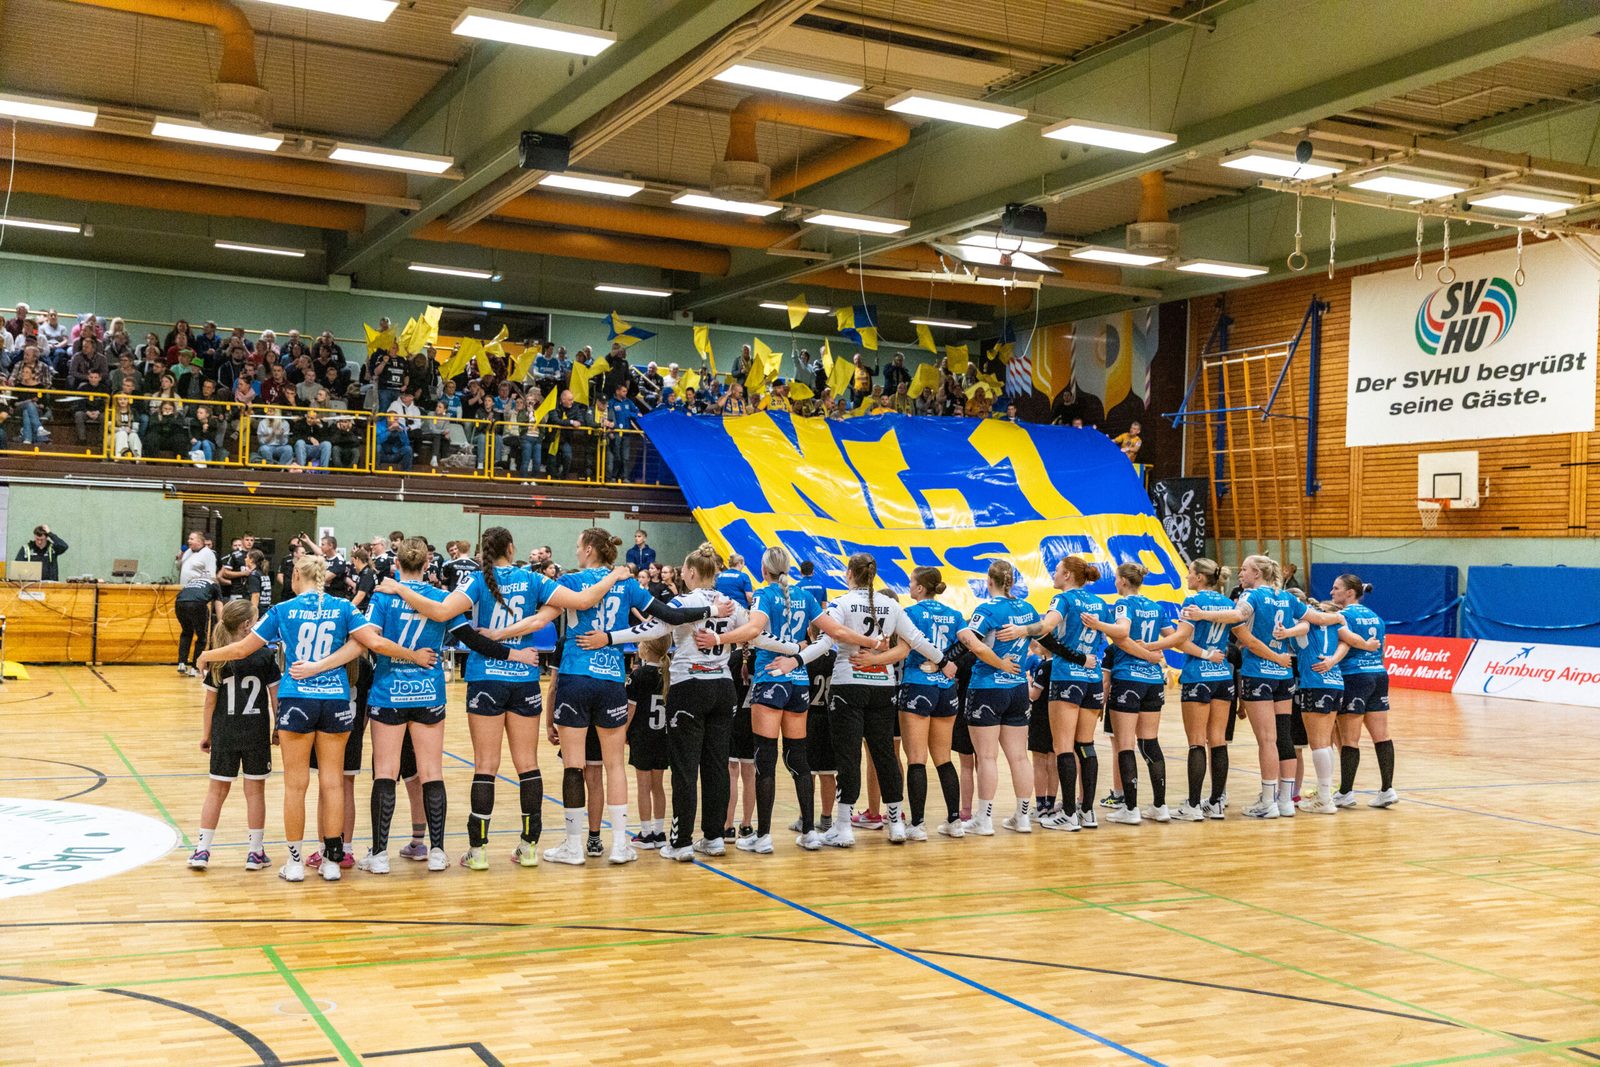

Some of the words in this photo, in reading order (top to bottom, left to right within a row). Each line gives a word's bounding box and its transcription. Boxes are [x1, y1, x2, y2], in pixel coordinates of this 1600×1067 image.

[1441, 277, 1488, 320] SV
[1441, 315, 1491, 355] HU
[1355, 375, 1397, 393] Der
[1402, 365, 1470, 389] SVHU
[1476, 352, 1587, 382] begrüßt
[1389, 396, 1454, 416] seine
[1461, 387, 1547, 410] Gäste.
[288, 609, 298, 620] SV
[391, 599, 400, 609] SV
[850, 604, 858, 613] SV
[295, 621, 336, 662] 86
[398, 612, 428, 651] 77
[1384, 646, 1412, 660] Dein
[1412, 647, 1451, 663] Markt
[1387, 663, 1413, 677] Dein
[1413, 665, 1453, 681] Markt.
[1484, 660, 1556, 682] Hamburg
[222, 675, 261, 715] 12
[390, 678, 437, 695] JODA
[649, 694, 667, 731] 5
[17, 846, 126, 872] DAS
